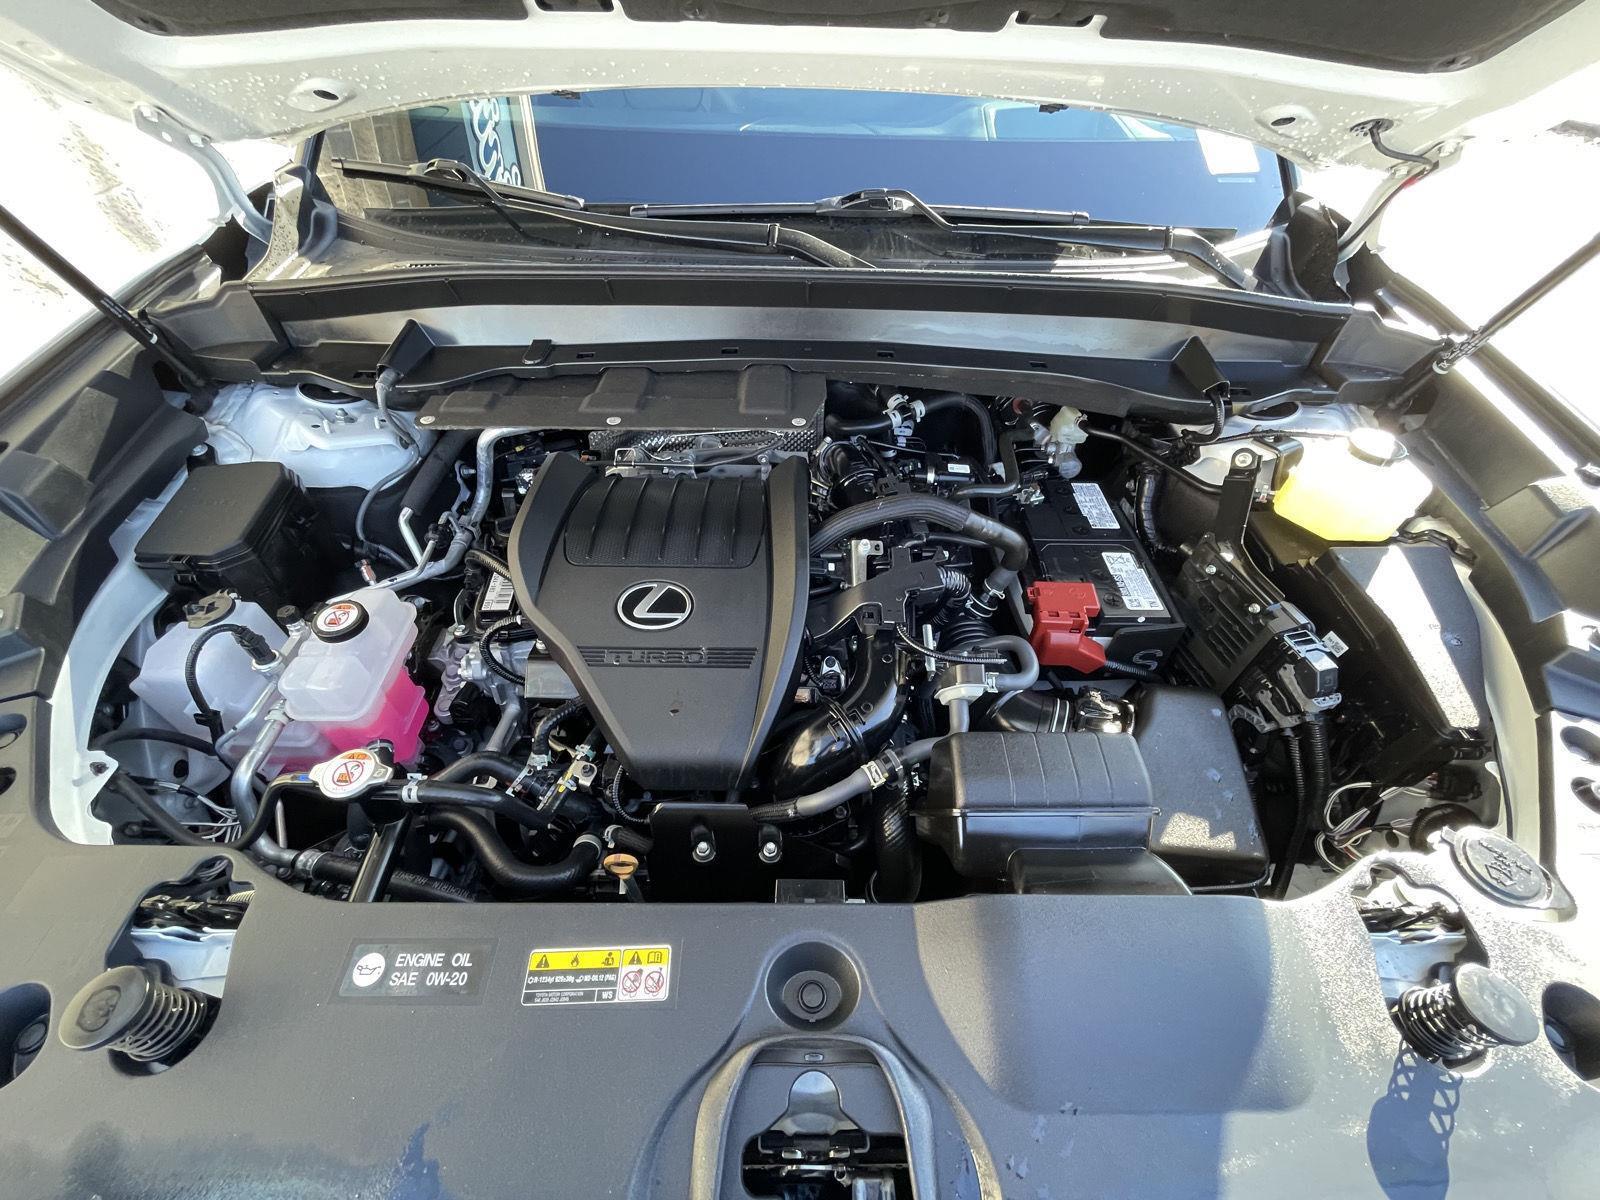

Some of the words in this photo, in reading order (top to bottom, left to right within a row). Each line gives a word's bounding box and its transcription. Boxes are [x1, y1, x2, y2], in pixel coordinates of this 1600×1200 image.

[603, 649, 706, 665] TURBO
[395, 952, 445, 967] ENGINE
[451, 952, 473, 967] OIL
[389, 971, 419, 986] SAE
[425, 971, 468, 986] 0W-20
[602, 991, 614, 1000] WS
